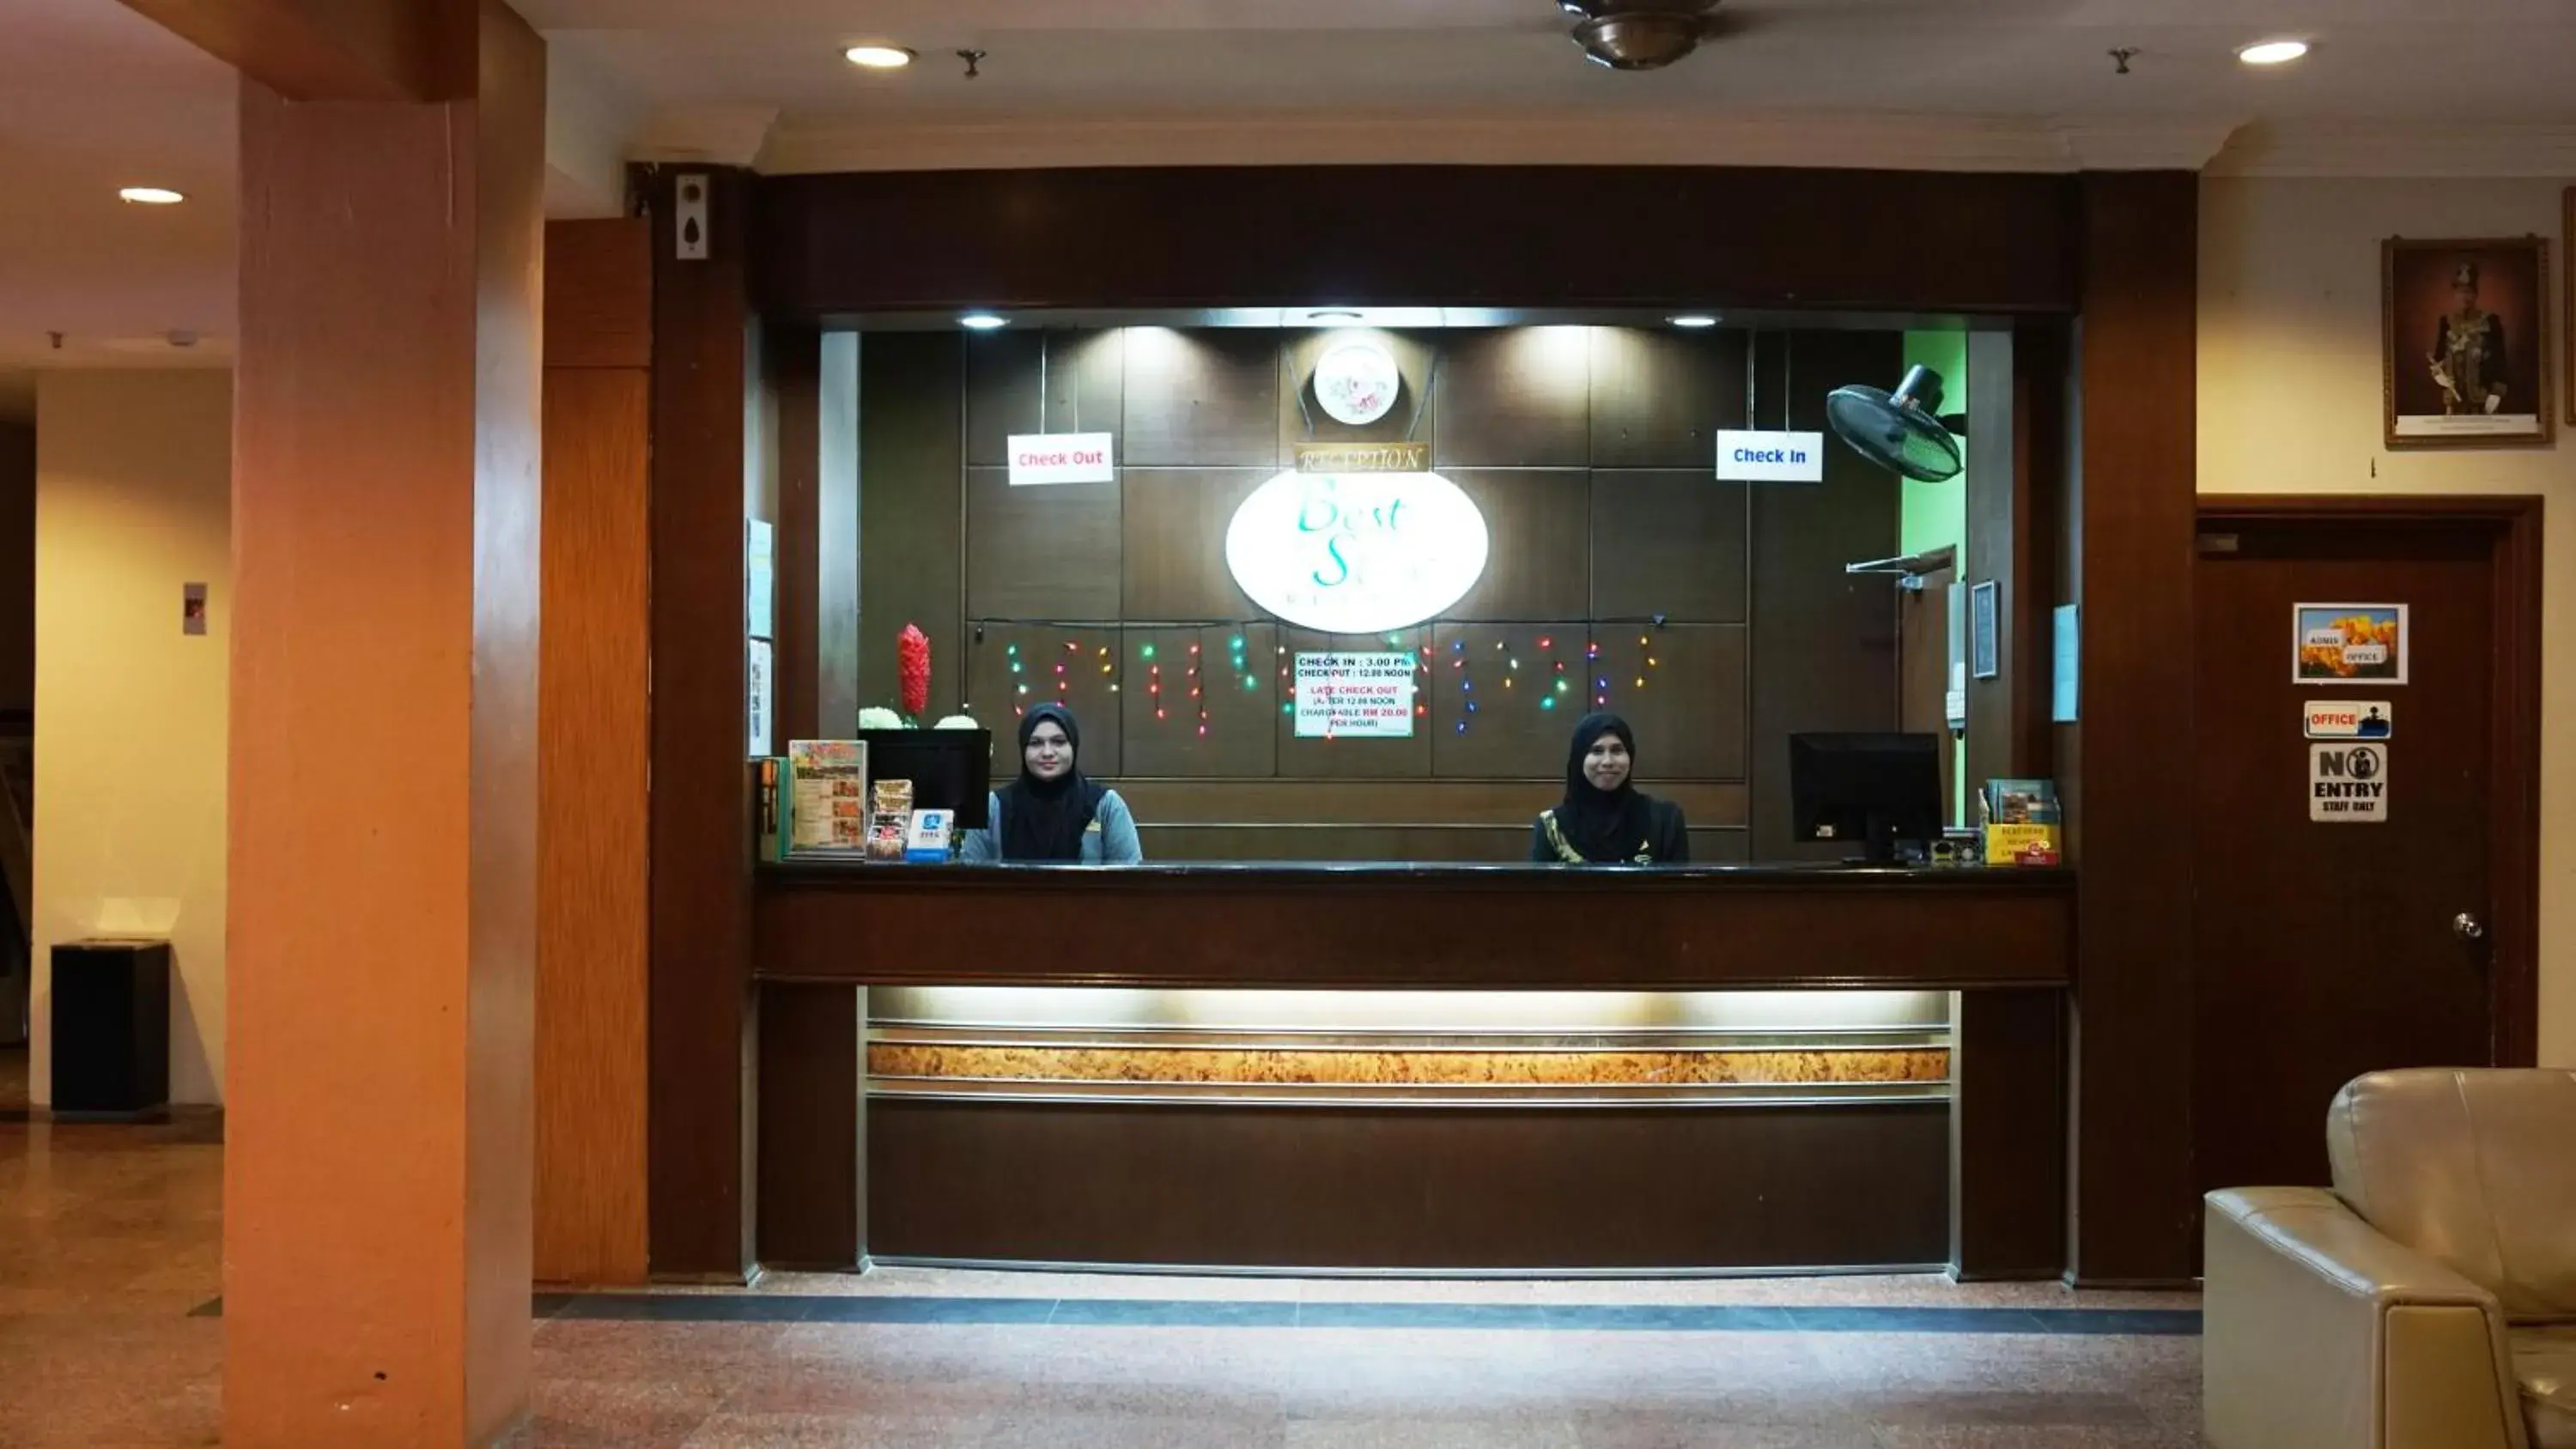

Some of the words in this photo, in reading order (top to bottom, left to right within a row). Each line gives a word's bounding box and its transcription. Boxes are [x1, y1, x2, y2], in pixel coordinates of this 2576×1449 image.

[1018, 452, 1066, 466] Check
[1073, 451, 1103, 464] Out
[1734, 448, 1784, 463] Check
[1790, 449, 1806, 464] In
[2346, 652, 2379, 662] OFFICE
[1299, 658, 1339, 667] CHECK
[1342, 658, 1356, 666] IN
[1366, 658, 1390, 666] 3.00
[1297, 669, 1328, 677] CHECK
[1331, 669, 1350, 677] OUT
[1383, 669, 1411, 677] NOON
[1310, 686, 1336, 694] LATE
[1339, 686, 1374, 694] CHECK
[1376, 686, 1398, 694] OUT
[1370, 696, 1395, 705] NOON
[1363, 708, 1378, 717] RM
[1381, 708, 1407, 717] 20.00
[1330, 719, 1347, 728] PER
[2311, 713, 2356, 725] OFFICE
[2314, 782, 2384, 797] ENTRY
[2323, 801, 2350, 812] STAFF
[2353, 801, 2375, 812] ONLY
